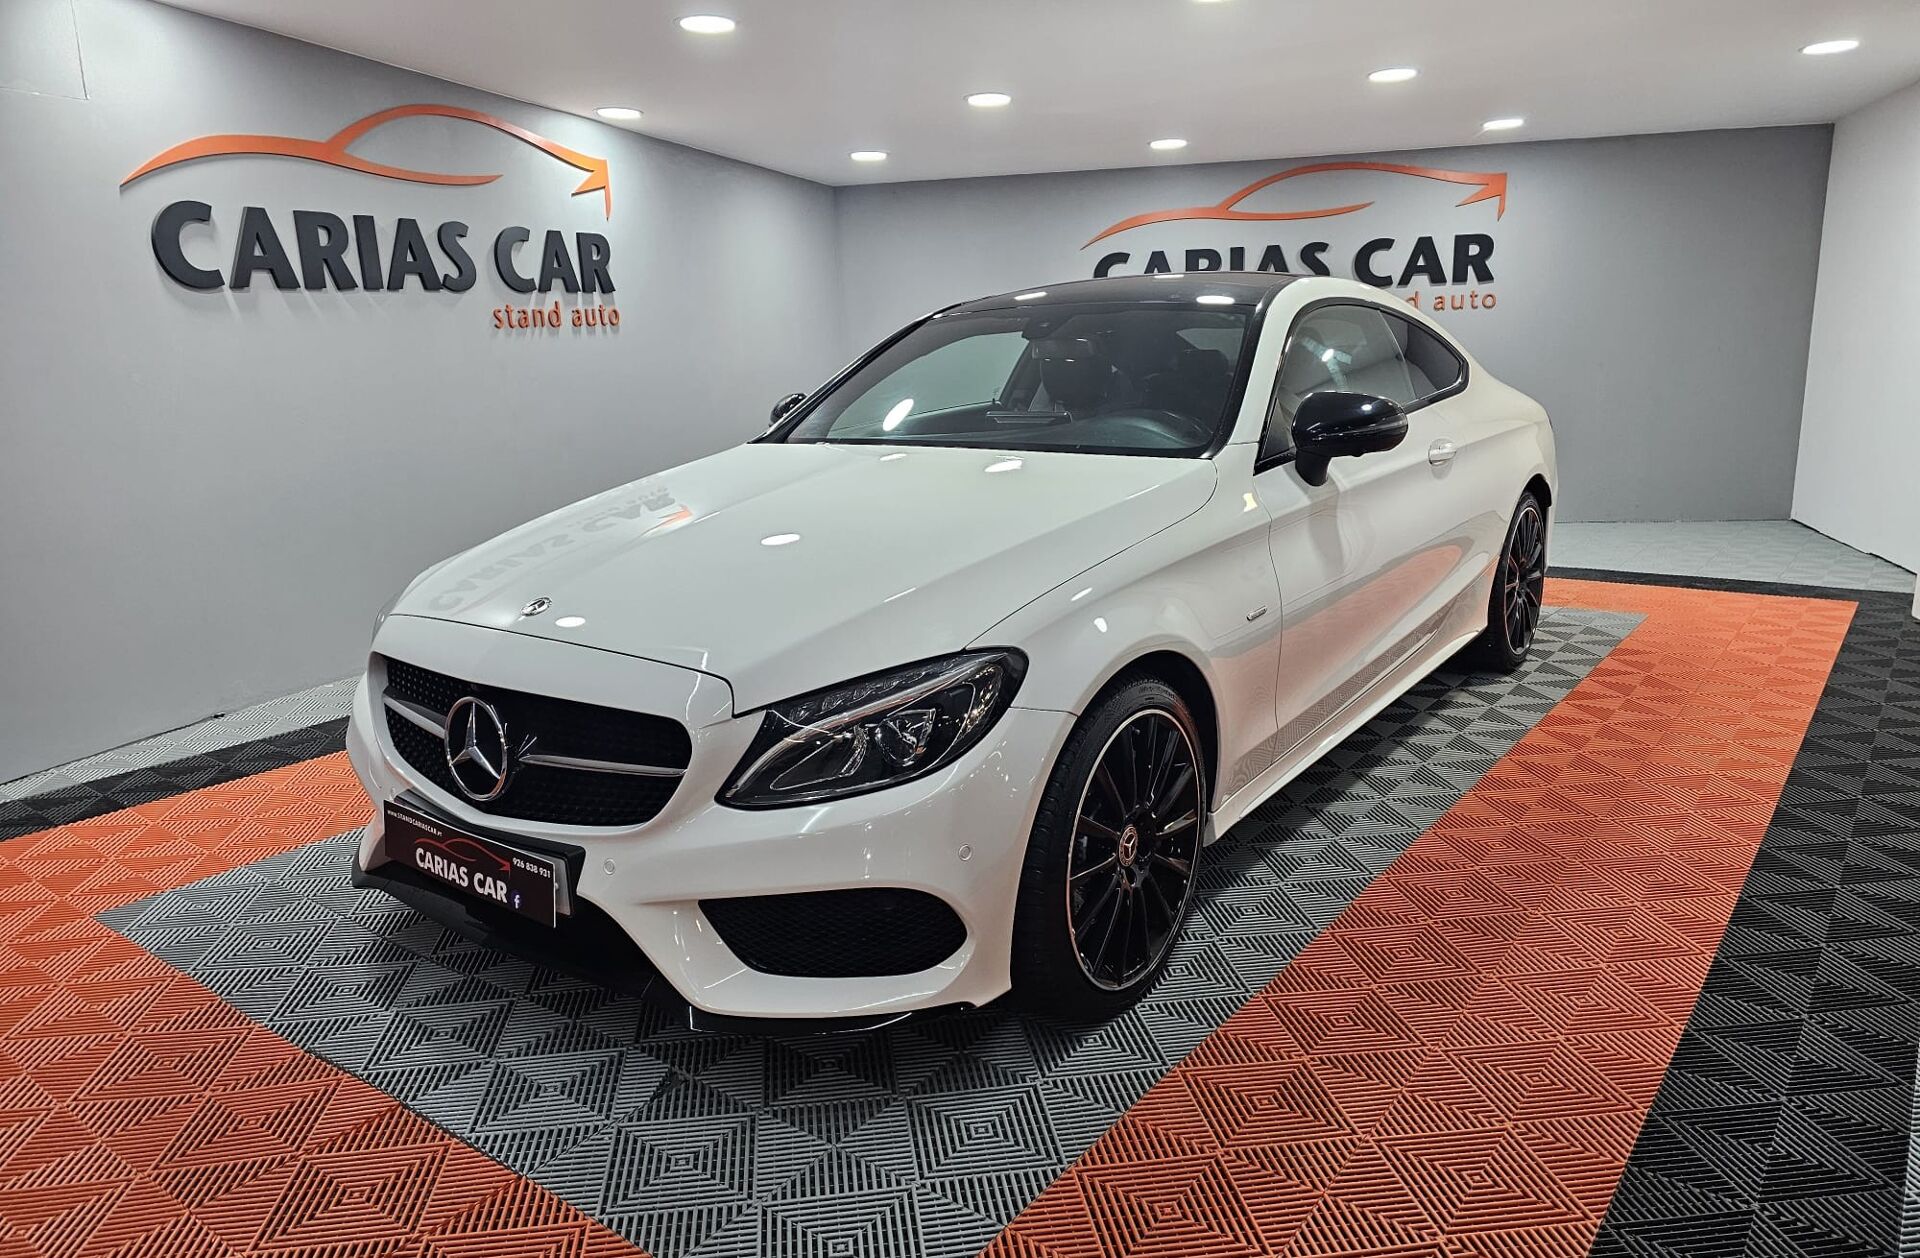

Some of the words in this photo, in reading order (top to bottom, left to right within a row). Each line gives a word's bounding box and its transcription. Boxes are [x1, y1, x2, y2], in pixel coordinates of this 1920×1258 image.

[151, 200, 477, 293] CARIAS
[494, 226, 616, 294] CAR
[1354, 232, 1496, 288] CAR
[493, 300, 562, 329] stand
[571, 304, 620, 328] auto
[1433, 290, 1497, 311] auto
[415, 847, 469, 887] CARIAS
[473, 872, 508, 903] CAR
[512, 857, 525, 869] 926
[525, 862, 538, 874] 838
[538, 867, 551, 879] 931
